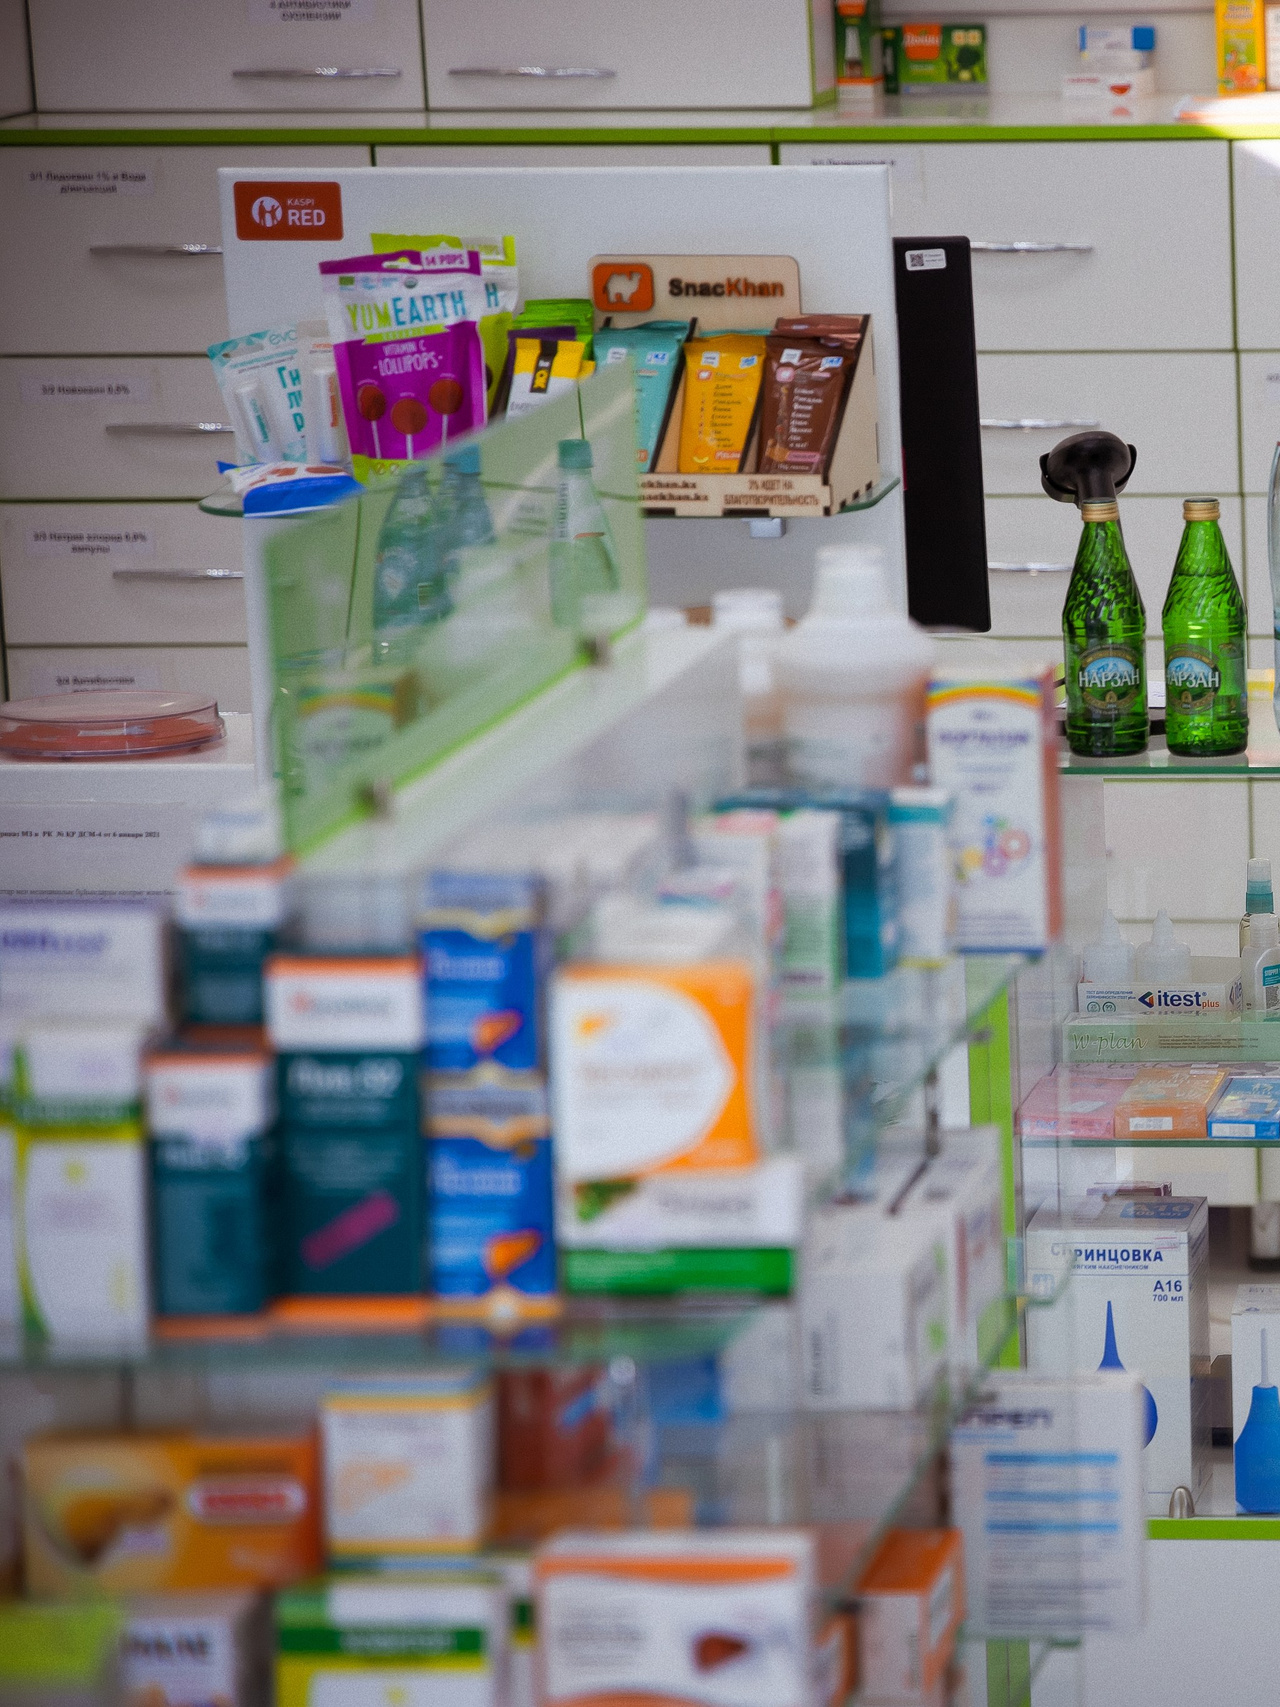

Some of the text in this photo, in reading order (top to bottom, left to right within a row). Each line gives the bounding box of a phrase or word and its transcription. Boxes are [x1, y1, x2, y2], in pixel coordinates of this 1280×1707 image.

[287, 198, 315, 206] KASPI
[287, 209, 326, 226] RED
[439, 253, 464, 267] POPS
[669, 277, 785, 298] SnacKhan
[1079, 668, 1140, 688] НАРЗАН
[1157, 990, 1220, 1010] itest plus
[1072, 1032, 1148, 1056] W-plan
[1153, 1280, 1182, 1292] А16
[1152, 1294, 1168, 1302] 700
